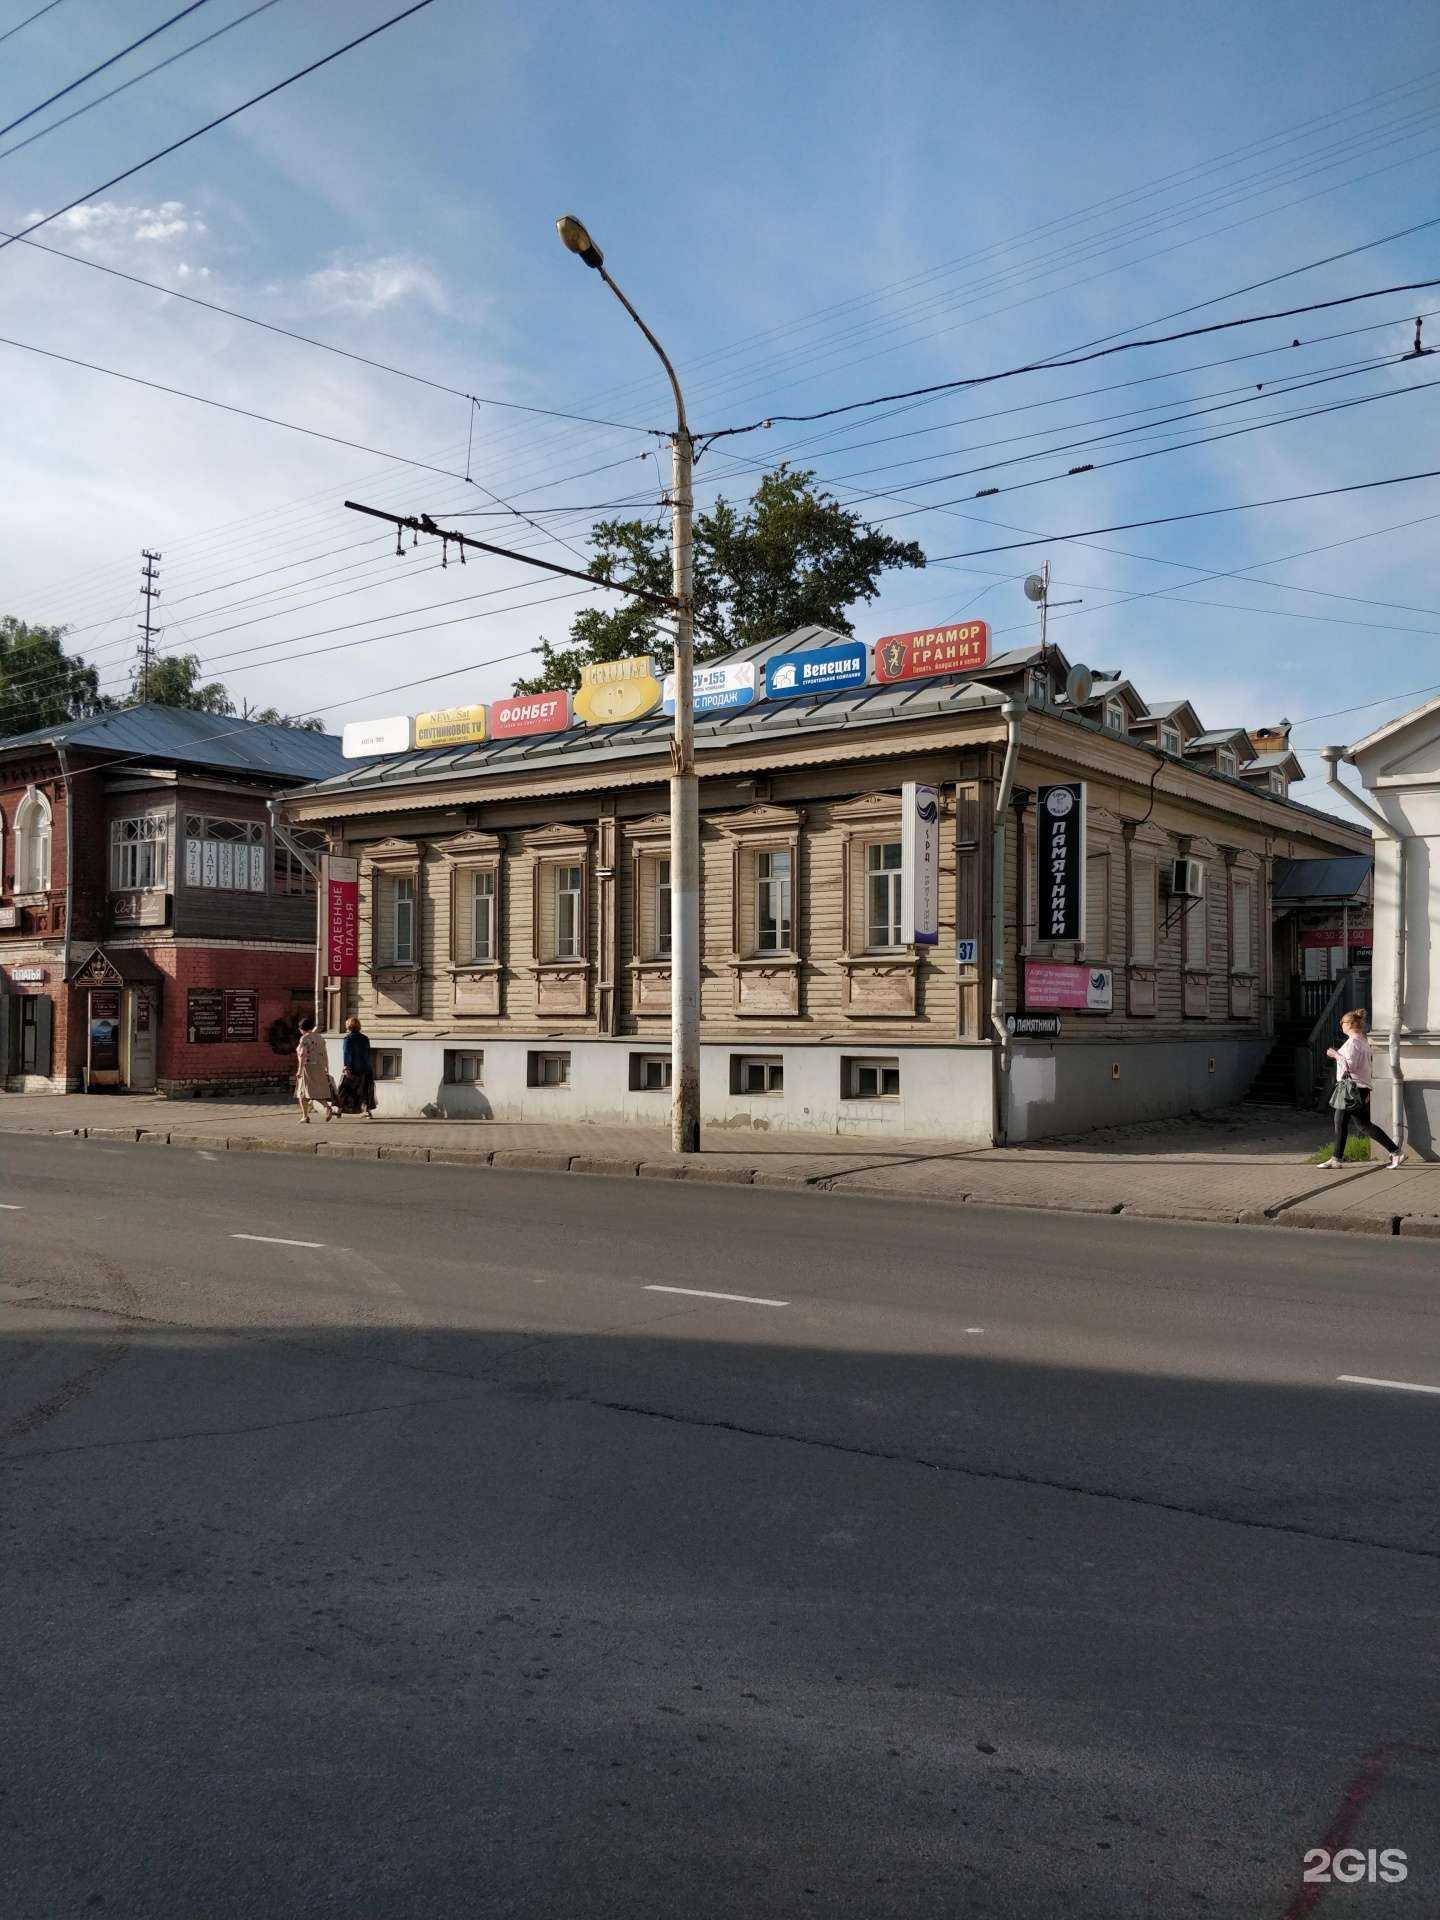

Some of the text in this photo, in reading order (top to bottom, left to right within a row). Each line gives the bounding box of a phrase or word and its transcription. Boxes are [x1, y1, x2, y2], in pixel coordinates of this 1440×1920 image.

[913, 626, 980, 648] МРАМОР
[912, 641, 980, 664] ГРАНИТ
[803, 657, 860, 678] Венеция
[702, 691, 738, 709] ПРОДАЖ
[500, 701, 558, 723] ФОНБЕТ
[418, 722, 471, 740] СПУТНИКОВОЕ
[472, 722, 482, 733] TV
[206, 842, 214, 886] ТАТУ
[1051, 821, 1068, 936] ПАМЯТНИКИ
[333, 887, 345, 972] СВАДЕБНЫЕ
[345, 903, 354, 956] ПЛАТЬЯ
[959, 942, 974, 961] 37
[1016, 1018, 1056, 1033] ПАМЯТНИКИ
